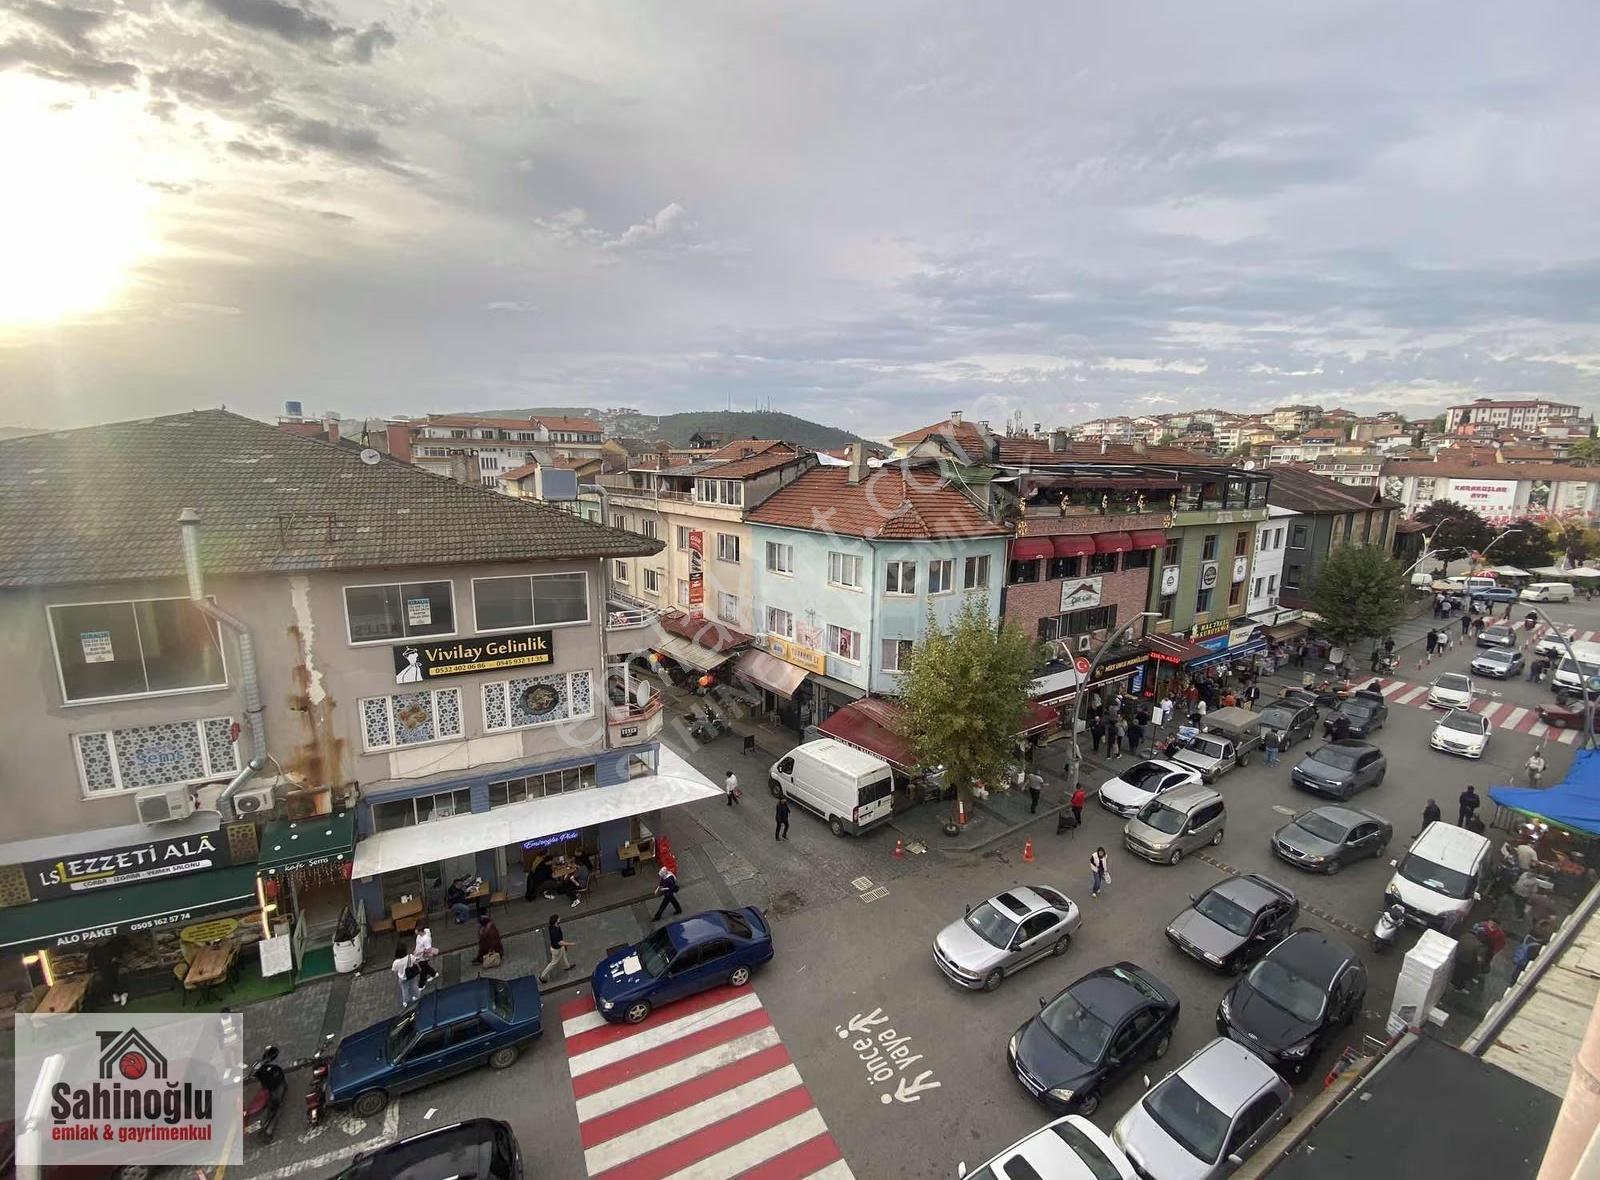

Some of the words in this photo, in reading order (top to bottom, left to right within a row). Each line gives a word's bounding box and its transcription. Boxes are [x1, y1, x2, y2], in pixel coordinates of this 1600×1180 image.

[425, 645, 482, 662] Vivilay
[486, 637, 547, 656] Gelinlik
[172, 862, 200, 872] SALONU
[57, 933, 79, 946] ALO
[82, 926, 118, 941] PAKET
[130, 920, 153, 931] 0505
[154, 917, 168, 926] 162
[169, 914, 179, 923] 57
[180, 912, 191, 920] 74
[853, 1038, 894, 1085] önce
